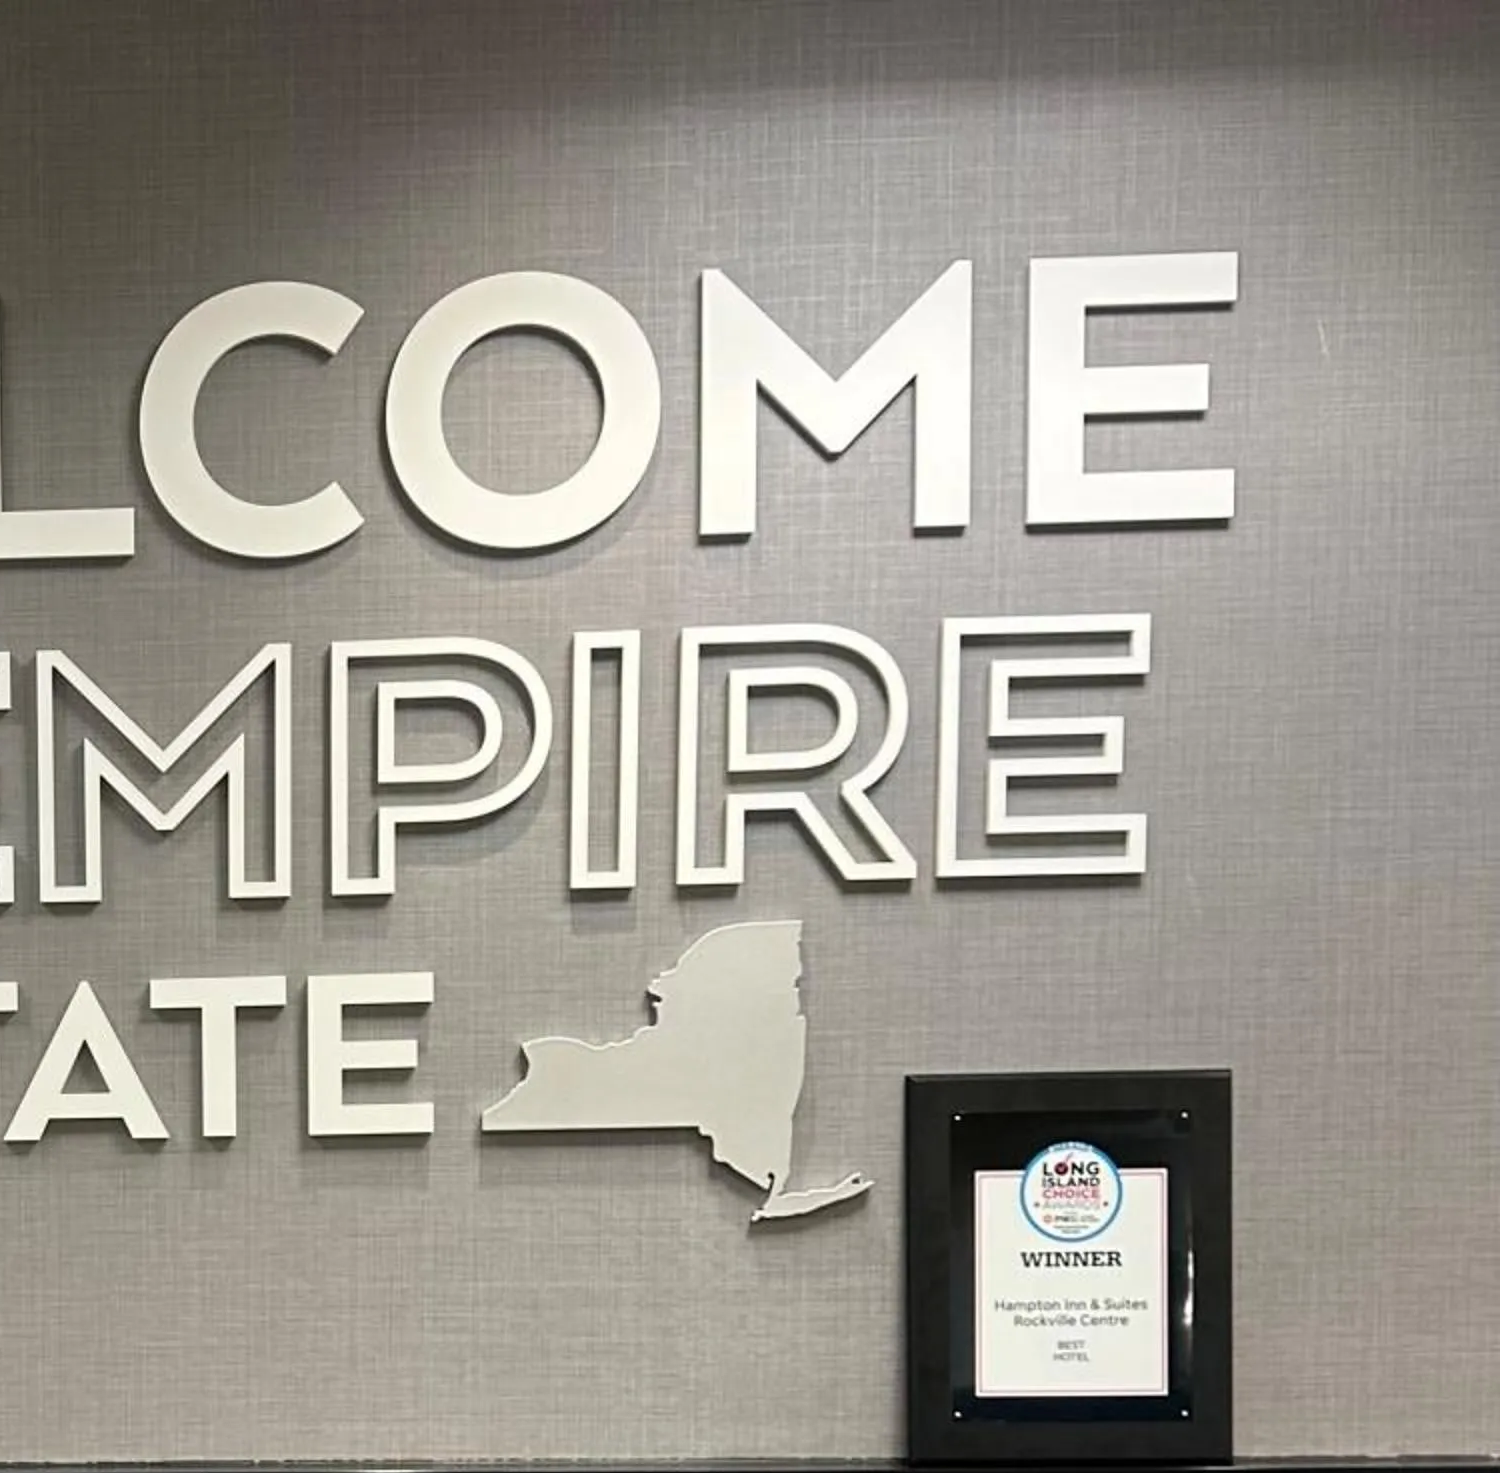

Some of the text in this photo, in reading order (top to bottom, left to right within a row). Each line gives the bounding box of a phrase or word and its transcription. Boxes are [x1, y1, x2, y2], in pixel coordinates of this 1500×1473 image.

[1043, 1161, 1100, 1176] LONG
[1042, 1177, 1100, 1189] ISLAND
[1043, 1188, 1100, 1199] CHOICE
[1020, 1251, 1122, 1267] WINNER
[995, 1298, 1148, 1313] Hampton Inn & Suites
[1014, 1314, 1129, 1327] Rockville Centre
[1057, 1340, 1085, 1350] BEST
[1053, 1351, 1090, 1362] HOTEL
